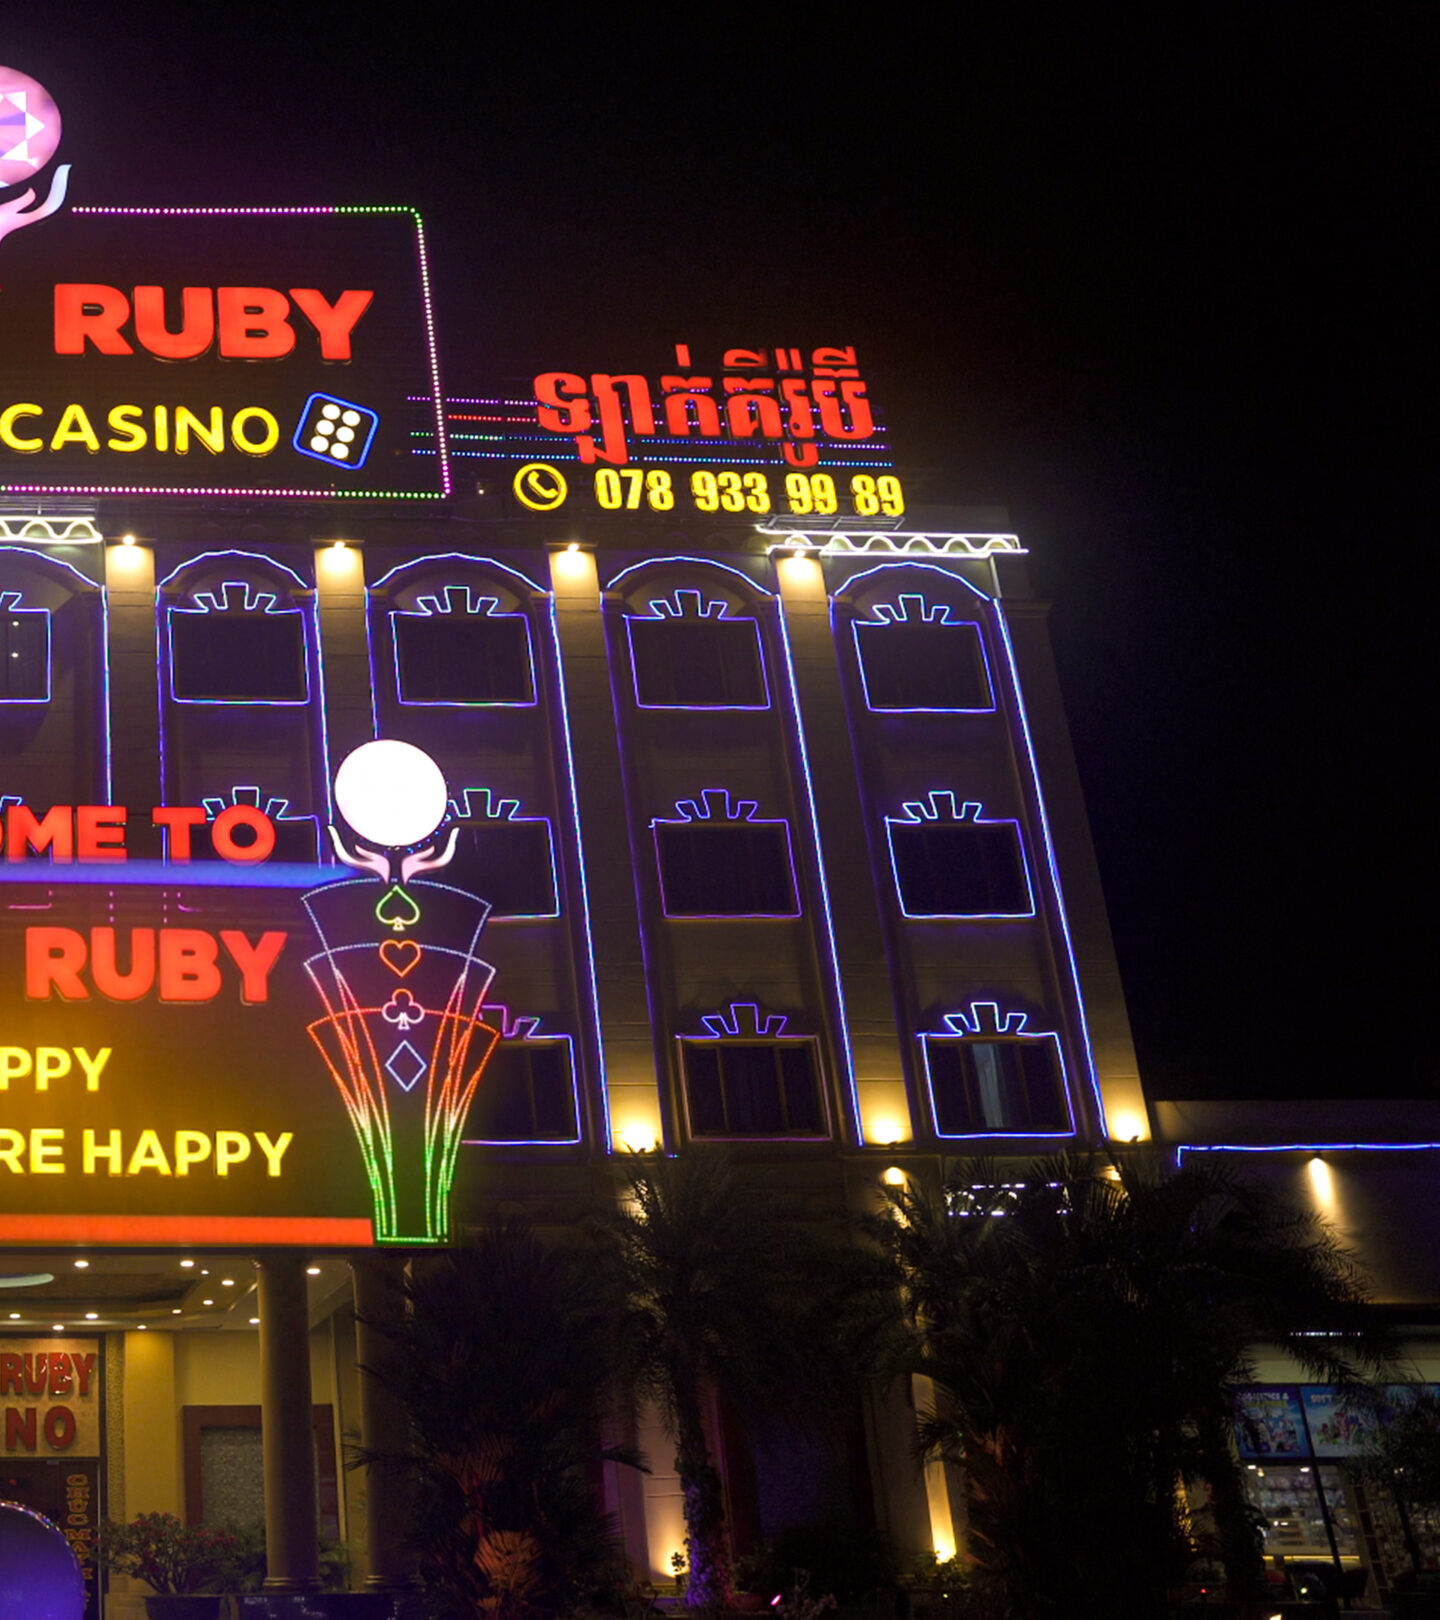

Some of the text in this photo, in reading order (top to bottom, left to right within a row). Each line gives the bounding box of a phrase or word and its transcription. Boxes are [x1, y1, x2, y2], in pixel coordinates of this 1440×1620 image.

[54, 284, 373, 359] RUBY
[0, 403, 279, 454] CASINO
[596, 469, 904, 516] 078 933 99 89
[153, 804, 276, 861] TO
[25, 926, 288, 1004] RUBY
[83, 1129, 293, 1177] HAPPY
[0, 1352, 96, 1396] RUBY
